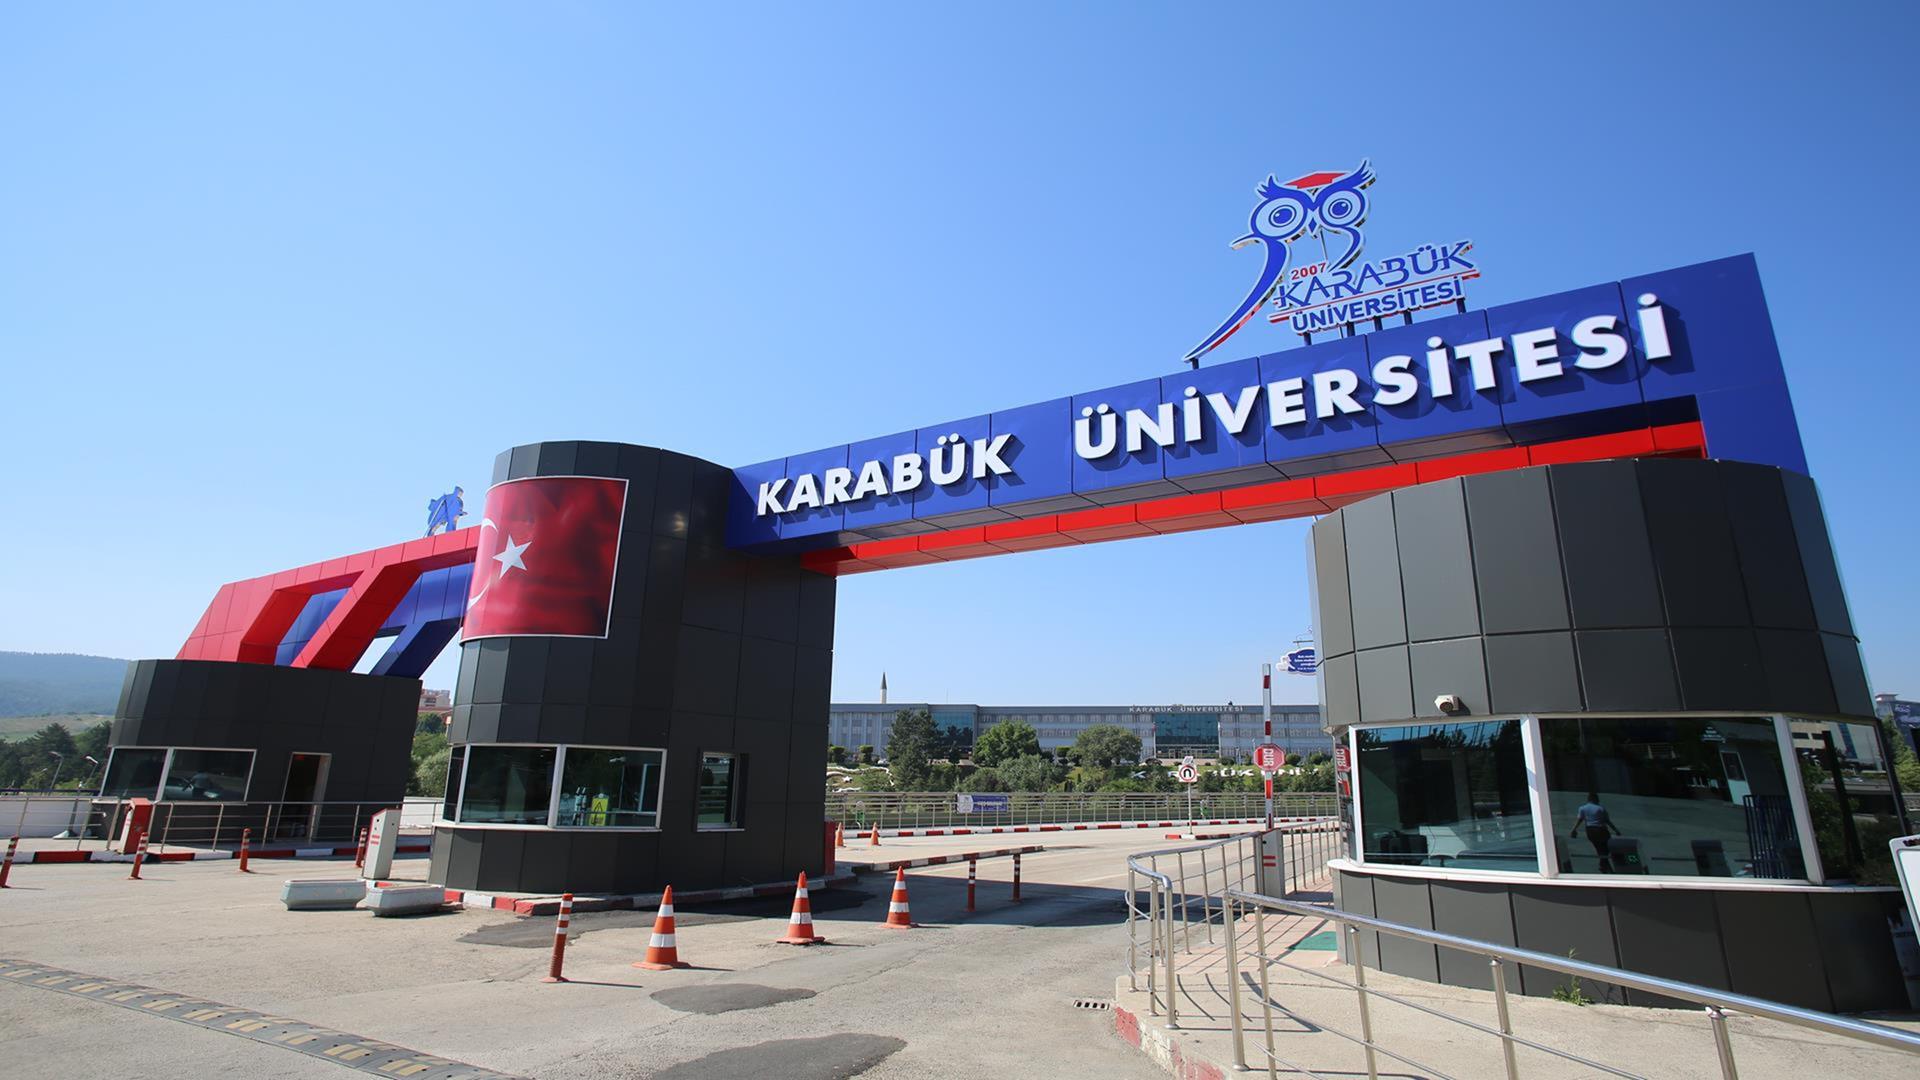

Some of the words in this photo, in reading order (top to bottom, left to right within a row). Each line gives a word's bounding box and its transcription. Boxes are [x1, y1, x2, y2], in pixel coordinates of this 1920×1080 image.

[1273, 240, 1474, 308] KARABÜK
[1291, 262, 1327, 280] 2007
[1291, 276, 1462, 332] ÜNİVERSİTESİ
[757, 433, 1015, 517] KARABÜK
[1075, 293, 1672, 460] ÜNİVERSİTESİ
[1263, 748, 1274, 766] DUR
